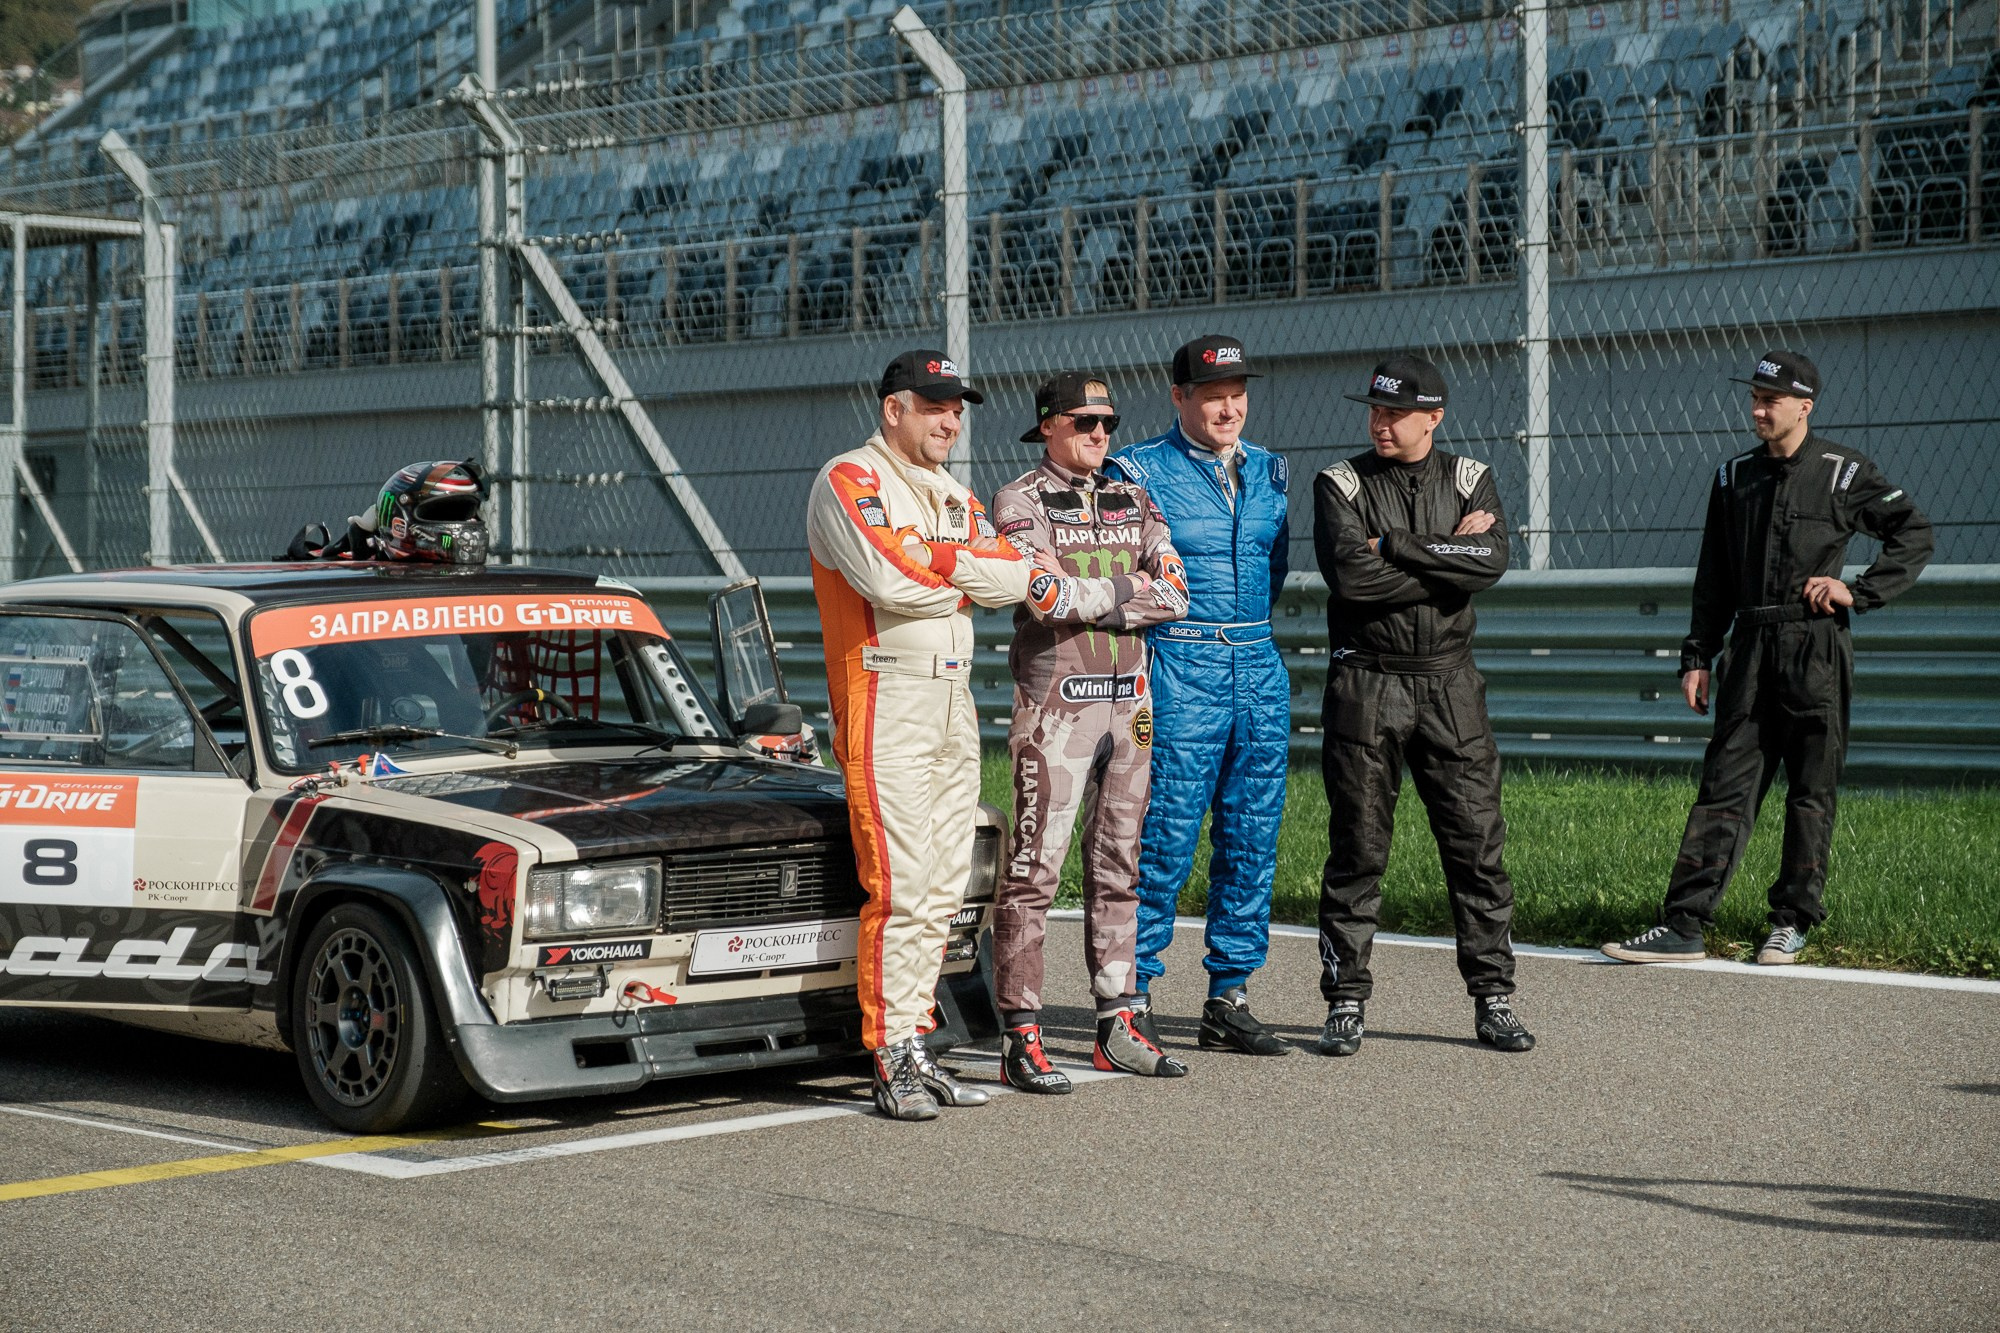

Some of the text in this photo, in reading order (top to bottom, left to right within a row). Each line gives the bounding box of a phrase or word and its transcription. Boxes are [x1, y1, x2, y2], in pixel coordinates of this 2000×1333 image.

[1126, 507, 1139, 516] GP
[1055, 524, 1142, 547] ДАРКСАЙД
[569, 599, 630, 608] ТОПЛИВО
[308, 603, 505, 639] ЗАПРАВЛЕНО
[1169, 626, 1202, 637] sparco
[270, 649, 329, 720] 8
[1069, 677, 1132, 697] Winline
[53, 782, 124, 790] ТОПЛИВО
[1010, 757, 1038, 879] ДАРКСАЙД
[22, 838, 78, 886] 8
[148, 880, 239, 892] РОСКОНГРЕСС
[148, 893, 189, 903] РК-Спорт
[744, 928, 842, 950] РОСКОНГРЕСС
[0, 927, 273, 986] ada
[570, 943, 644, 961] YOKOHAMA
[740, 952, 787, 964] РК-Спорт
